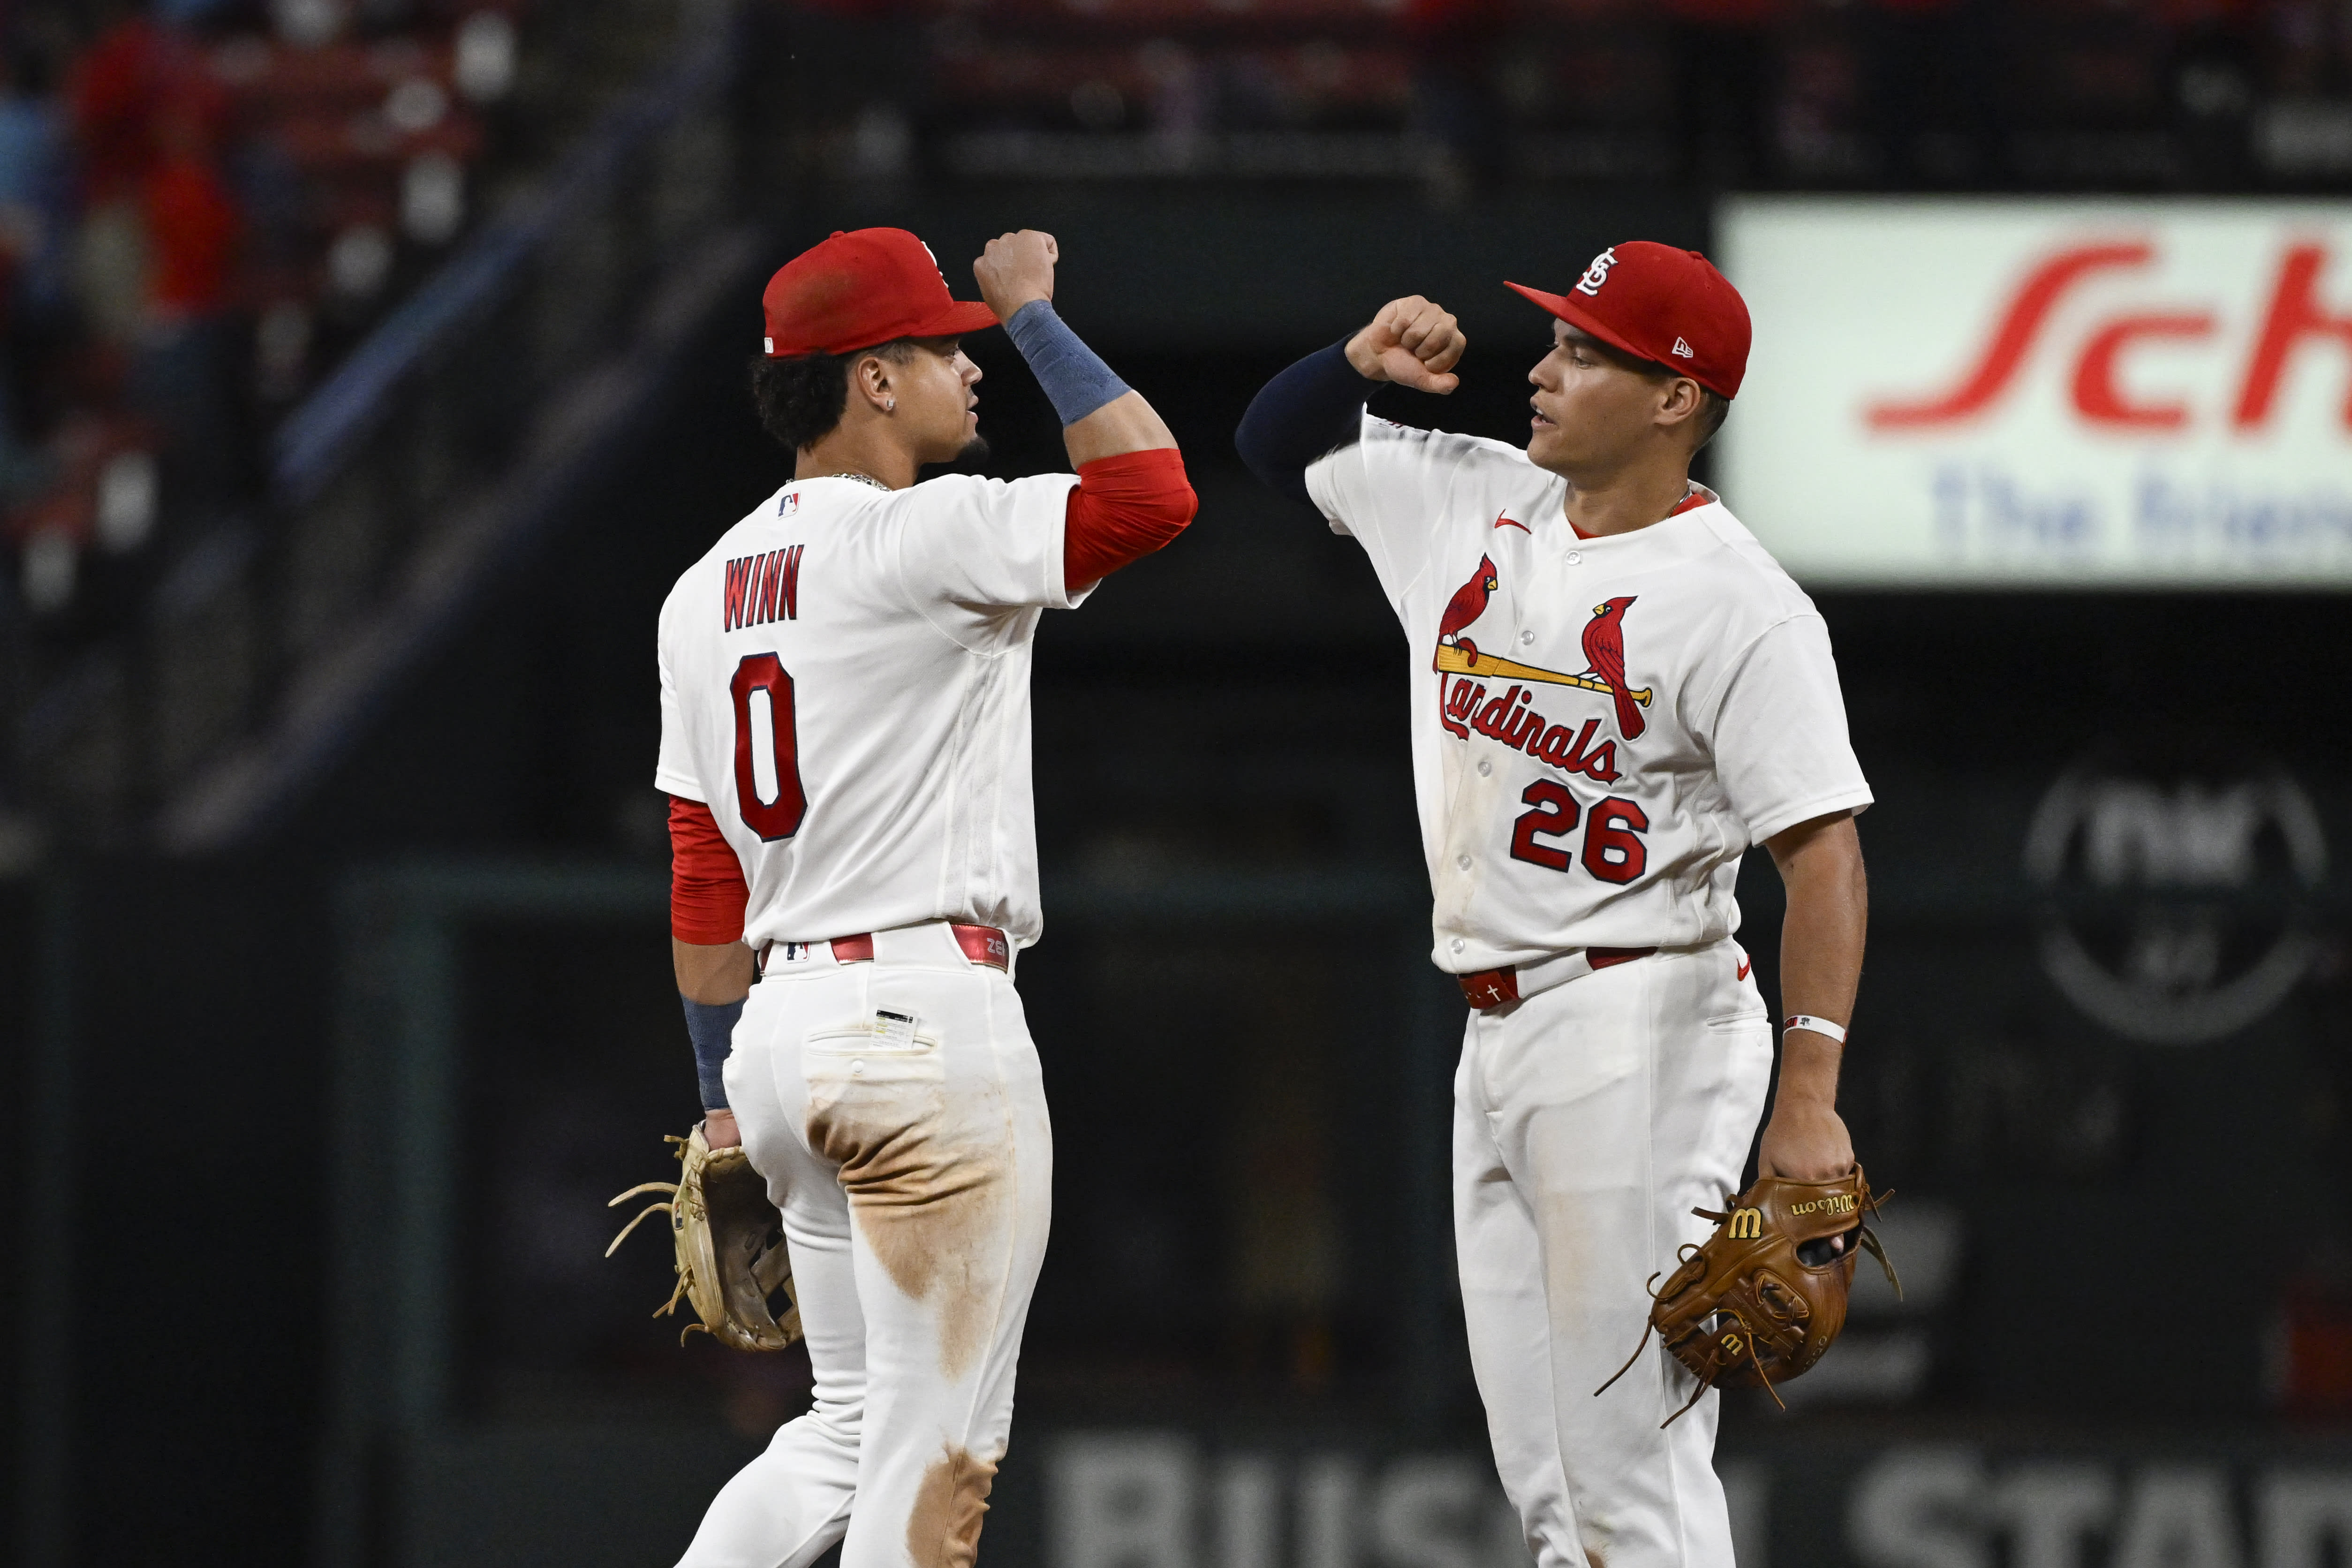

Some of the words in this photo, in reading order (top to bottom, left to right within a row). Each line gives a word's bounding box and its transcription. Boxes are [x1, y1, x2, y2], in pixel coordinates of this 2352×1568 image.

[724, 544, 804, 632] WINN
[730, 651, 808, 842] 0
[1440, 638, 1622, 786] Cardinals
[1510, 778, 1649, 885] 26
[1790, 1194, 1854, 1216] Wilson
